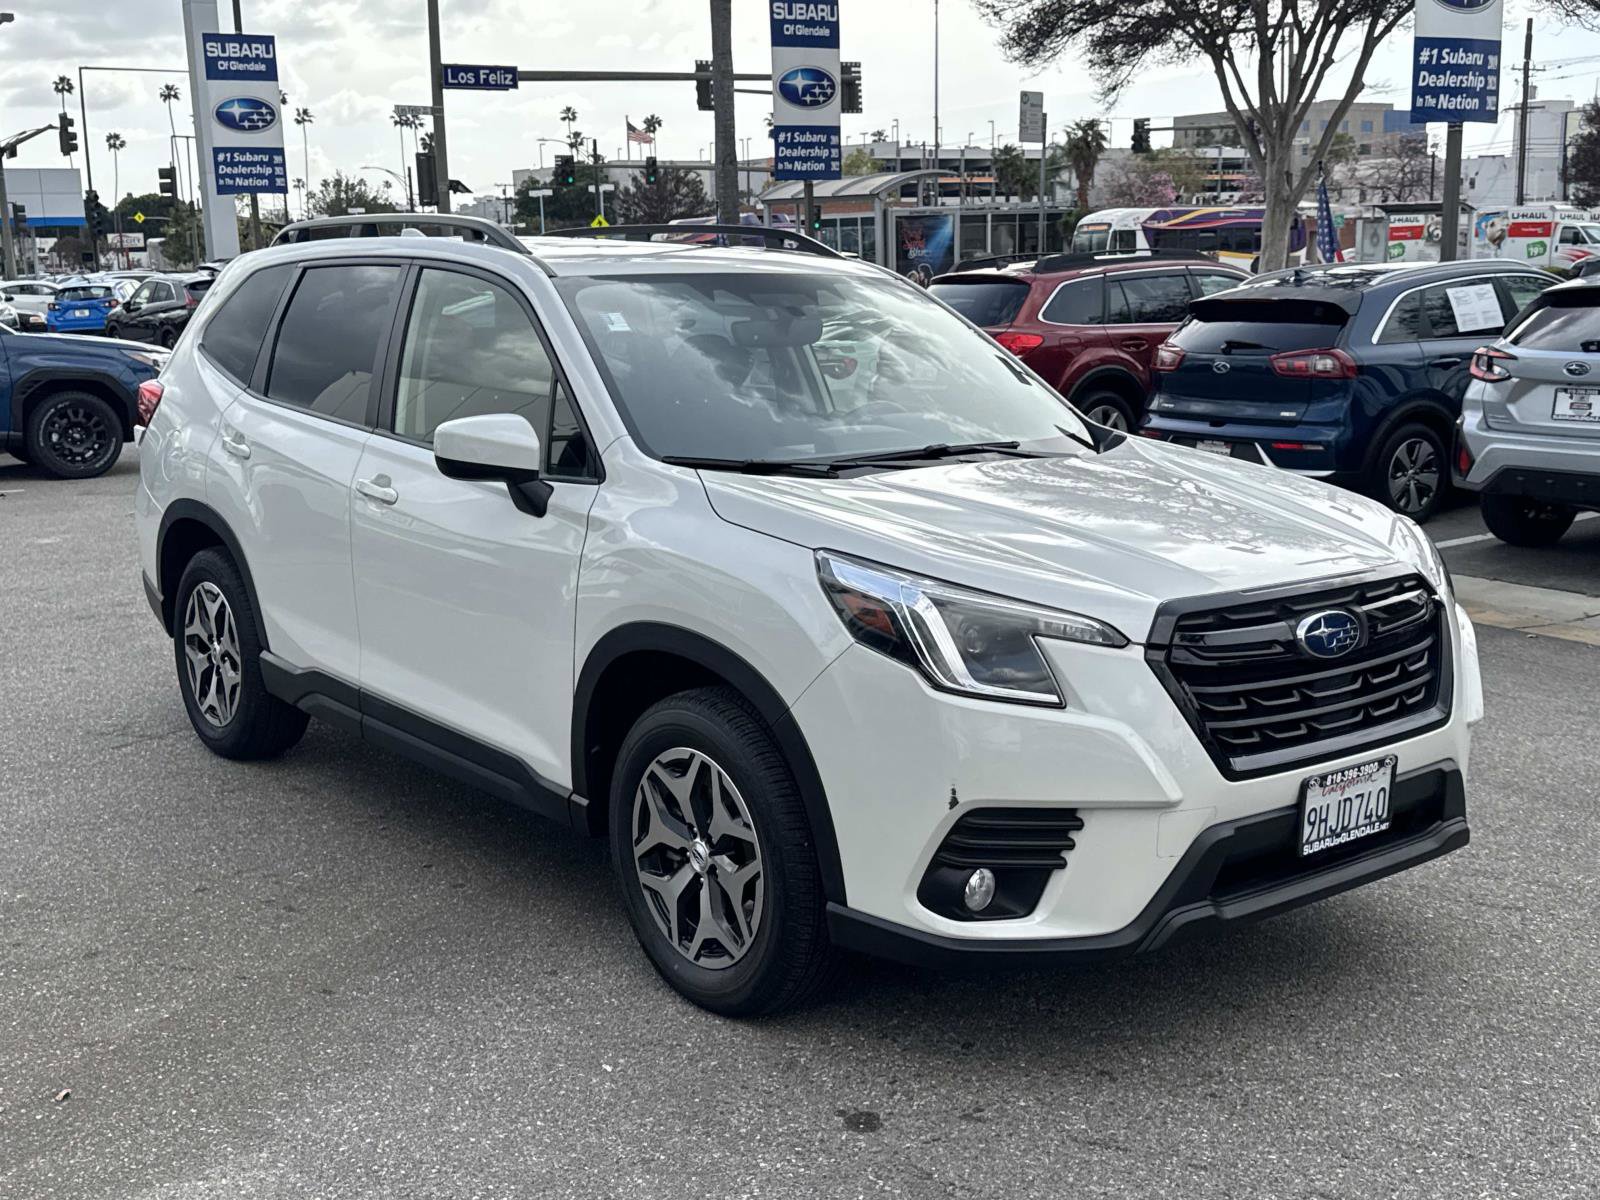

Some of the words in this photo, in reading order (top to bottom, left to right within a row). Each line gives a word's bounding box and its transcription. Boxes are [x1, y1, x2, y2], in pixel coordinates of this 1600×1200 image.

[773, 2, 838, 21] SUBARU
[783, 24, 794, 35] Of
[795, 24, 830, 37] Glendale
[206, 42, 274, 59] SUBARU
[1418, 47, 1439, 65] #1
[1440, 47, 1484, 66] Subaru
[217, 60, 228, 71] Of
[229, 61, 266, 72] Glendale
[447, 68, 476, 84] Los
[479, 69, 514, 85] Feliz
[1418, 70, 1485, 92] Dealership
[1416, 95, 1424, 107] In
[1424, 95, 1437, 107] The
[1437, 93, 1479, 110] Nation
[778, 131, 791, 143] #1
[793, 131, 827, 143] Subaru
[217, 152, 231, 162] #1
[233, 152, 269, 162] Subaru
[778, 145, 829, 159] Dealership
[218, 164, 273, 176] Dealership
[793, 160, 826, 171] Nation
[234, 177, 269, 187] Nation
[1511, 212, 1548, 220] U-HAUL
[1560, 213, 1585, 221] U-HAUL
[1304, 787, 1387, 842] 9HJD740
